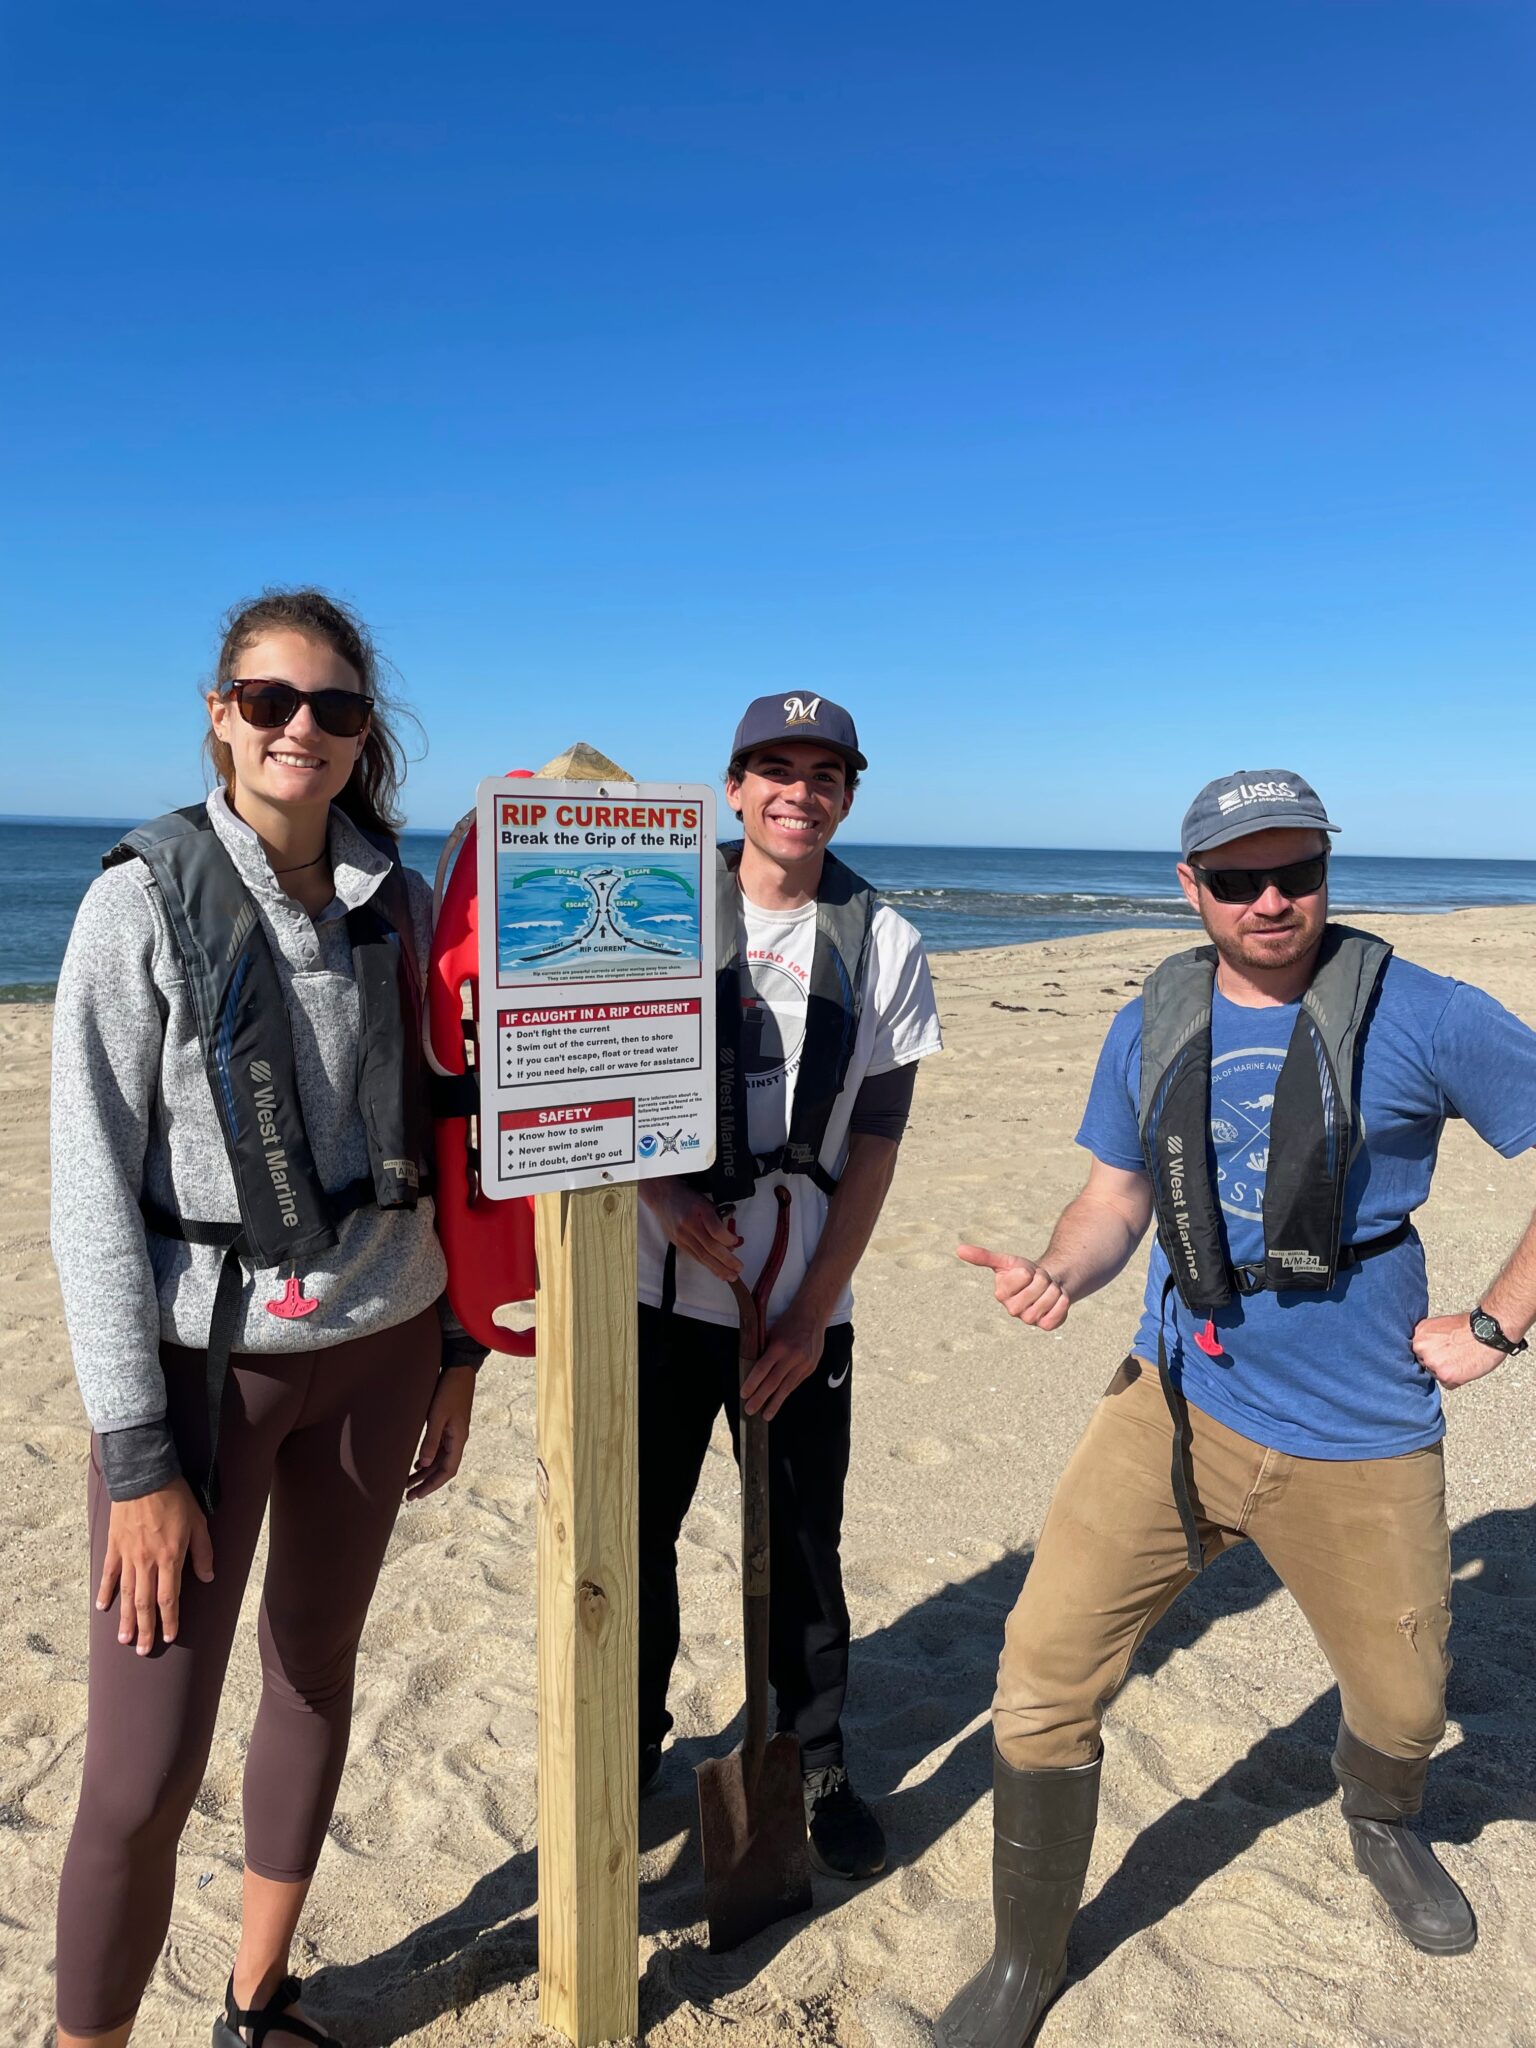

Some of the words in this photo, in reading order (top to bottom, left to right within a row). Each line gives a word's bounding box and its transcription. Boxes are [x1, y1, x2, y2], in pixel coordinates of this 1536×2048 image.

[1240, 781, 1296, 799] USGS
[502, 804, 547, 826] RIP
[556, 805, 697, 829] CURRENTS
[501, 831, 549, 845] Break
[554, 832, 579, 845] the
[584, 832, 616, 848] Grip
[621, 833, 636, 845] of
[641, 833, 665, 846] the
[670, 833, 697, 849] Rip!
[554, 868, 578, 877] ESCAPE
[628, 868, 651, 876] ESCAPE
[565, 901, 589, 909] ESCAPE
[616, 900, 638, 908] ESCAPE
[542, 941, 564, 952] CURRENT
[593, 945, 627, 953] CURRENT
[643, 939, 665, 948] CURRENT
[748, 950, 784, 964] HEAD
[787, 961, 809, 981] 10K
[506, 1013, 518, 1025] IF
[522, 1009, 577, 1024] CAUGHT
[580, 1008, 594, 1020] IN
[597, 1008, 607, 1019] A
[609, 1006, 630, 1018] RIP
[633, 1002, 690, 1016] CURRENT
[516, 1029, 540, 1039] Don't
[541, 1028, 561, 1038] fight
[563, 1027, 577, 1035] the
[579, 1025, 610, 1034] current
[516, 1043, 541, 1052] Swim
[543, 1042, 557, 1050] out
[559, 1041, 568, 1049] of
[570, 1039, 584, 1047] the
[586, 1037, 619, 1046] current,
[621, 1036, 639, 1044] then
[651, 1033, 674, 1041] shore
[517, 1057, 524, 1065] If
[526, 1057, 542, 1066] you
[544, 1054, 565, 1063] can't
[567, 1053, 600, 1061] escape,
[602, 1050, 621, 1058] float
[633, 1047, 654, 1055] tread
[656, 1045, 679, 1053] water
[526, 1071, 542, 1079] you
[544, 1067, 565, 1076] need
[567, 1065, 588, 1074] help,
[589, 1063, 605, 1072] call
[617, 1061, 638, 1069] wave
[653, 1057, 695, 1066] assistance
[1222, 1068, 1233, 1077] OF
[1233, 1062, 1264, 1073] MARINE
[719, 1067, 735, 1112] West
[253, 1085, 283, 1146] West
[538, 1107, 592, 1124] SAFETY
[519, 1131, 545, 1141] Know
[547, 1129, 567, 1138] how
[569, 1127, 578, 1135] to
[580, 1124, 604, 1133] swim
[519, 1145, 546, 1155] Never
[548, 1142, 572, 1151] swim
[574, 1139, 599, 1148] alone
[720, 1116, 737, 1177] Marine
[519, 1161, 526, 1169] If
[528, 1160, 537, 1168] in
[539, 1156, 569, 1166] doubt,
[571, 1152, 593, 1162] don't
[595, 1152, 606, 1161] go
[608, 1149, 623, 1157] out
[264, 1149, 299, 1228] Marine
[1168, 1157, 1187, 1208] West
[1175, 1212, 1199, 1280] Marine
[1283, 1257, 1318, 1266] A/M-24
